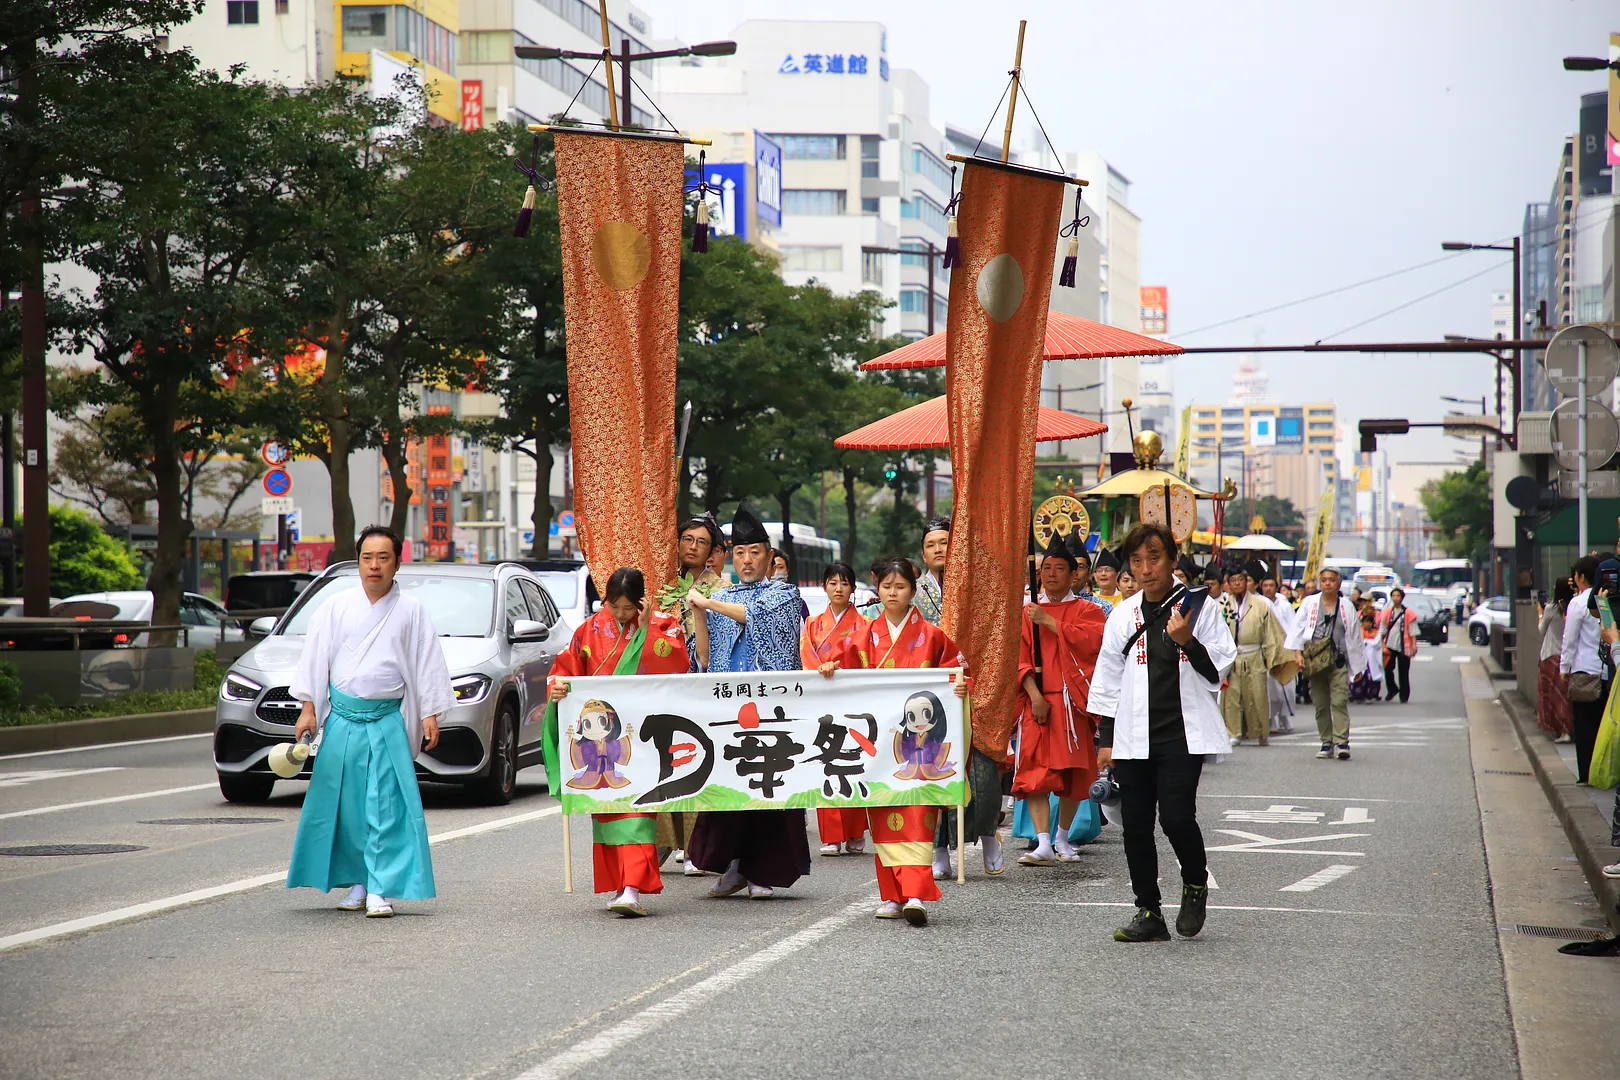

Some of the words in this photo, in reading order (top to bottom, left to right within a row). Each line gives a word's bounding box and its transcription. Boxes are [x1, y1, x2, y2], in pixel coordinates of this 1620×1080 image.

[803, 53, 868, 74] 英進館
[713, 681, 805, 699] 福岡まつり
[632, 701, 878, 806] 月華祭
